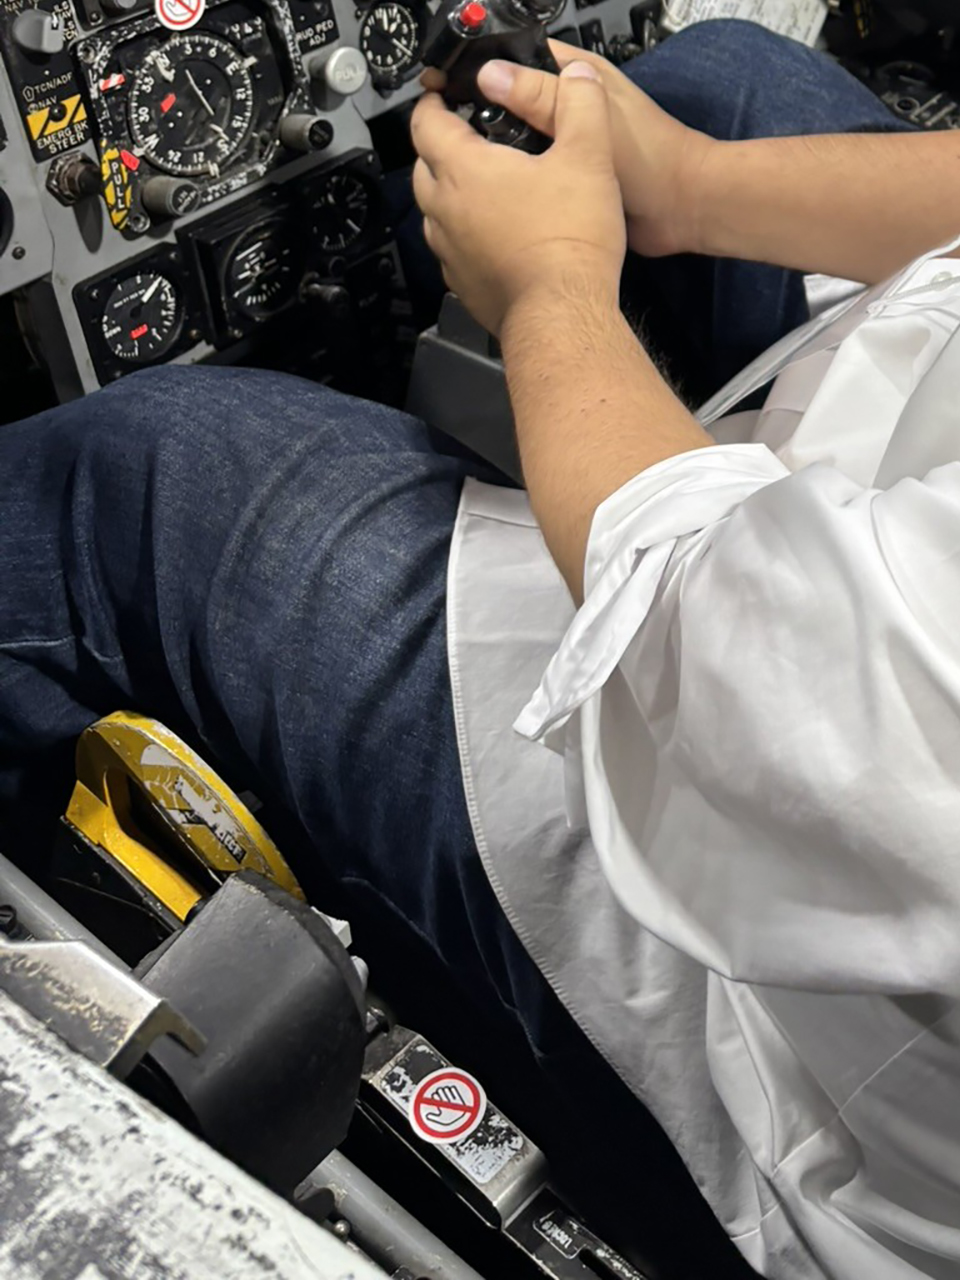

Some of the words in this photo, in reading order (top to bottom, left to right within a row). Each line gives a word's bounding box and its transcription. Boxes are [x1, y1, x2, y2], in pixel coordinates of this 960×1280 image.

[4, 0, 24, 12] NAV
[315, 19, 334, 33] PED
[309, 33, 326, 47] ADJ
[35, 71, 73, 94] TCN/ADF
[38, 95, 58, 108] NAV
[36, 127, 72, 150] EMERG
[74, 120, 89, 133] BK
[49, 131, 85, 154] STEER
[111, 161, 125, 209] PULL
